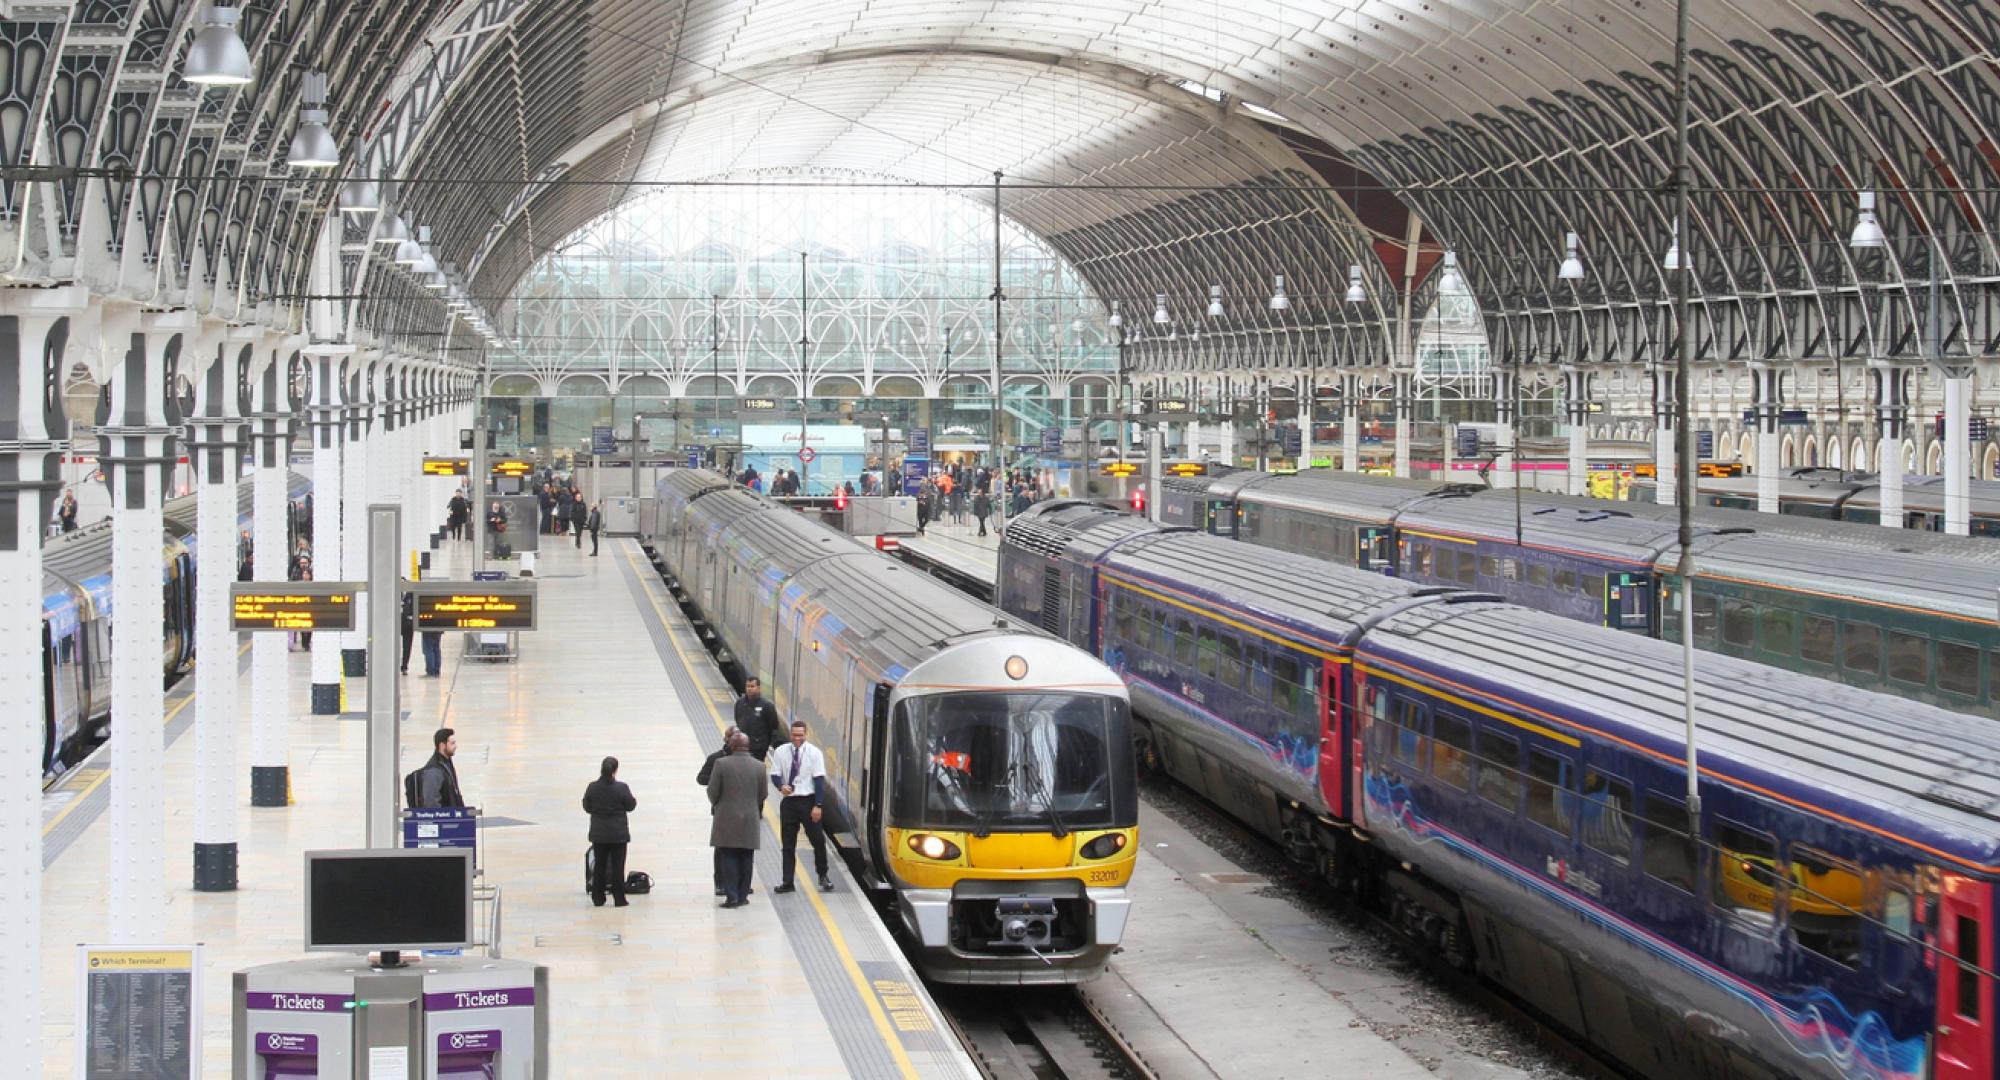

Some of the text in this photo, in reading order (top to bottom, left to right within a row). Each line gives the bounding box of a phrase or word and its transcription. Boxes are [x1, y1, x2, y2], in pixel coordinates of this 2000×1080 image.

[1089, 870, 1119, 881] 332010
[101, 957, 166, 965] Which Terminal?
[272, 994, 325, 1009] Tickets
[455, 991, 509, 1007] Tickets
